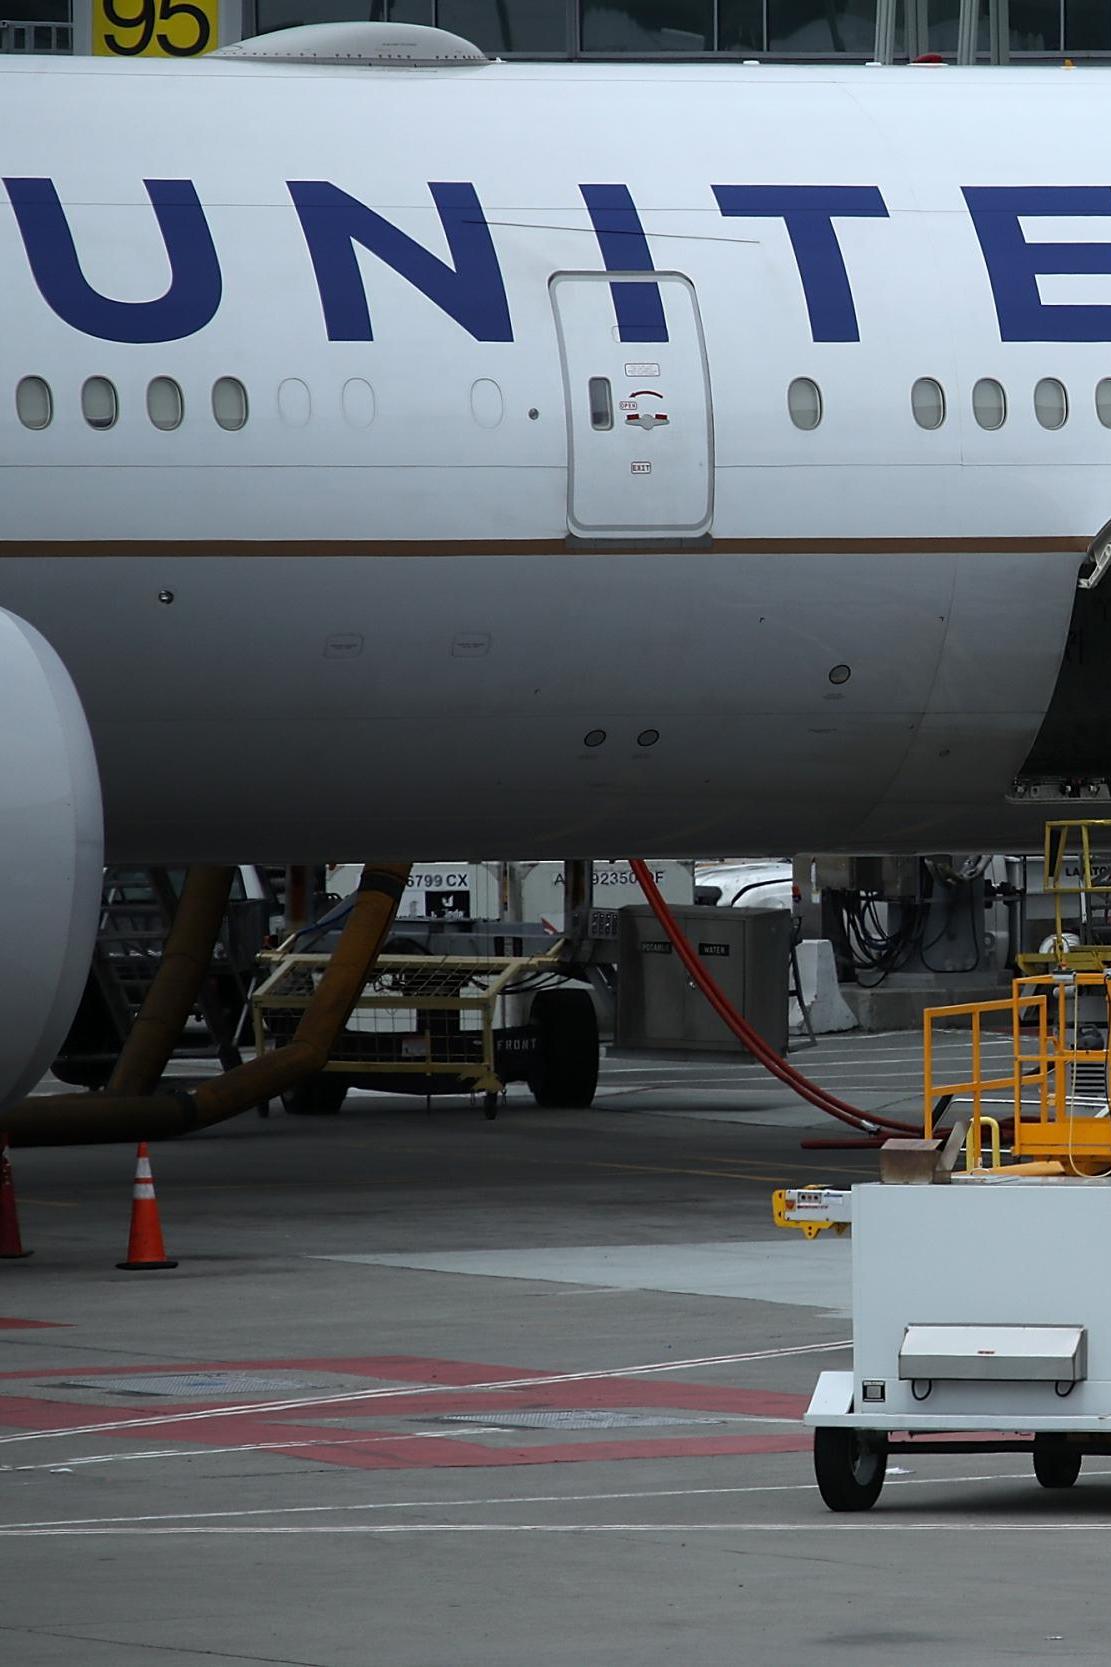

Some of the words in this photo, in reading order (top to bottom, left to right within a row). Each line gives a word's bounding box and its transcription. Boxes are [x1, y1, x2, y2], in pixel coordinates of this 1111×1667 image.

[103, 0, 210, 56] 95
[632, 464, 651, 472] EXIT
[405, 874, 443, 888] 6799
[446, 874, 468, 887] CX
[704, 946, 725, 954] WATER
[497, 1037, 537, 1050] FRONT
